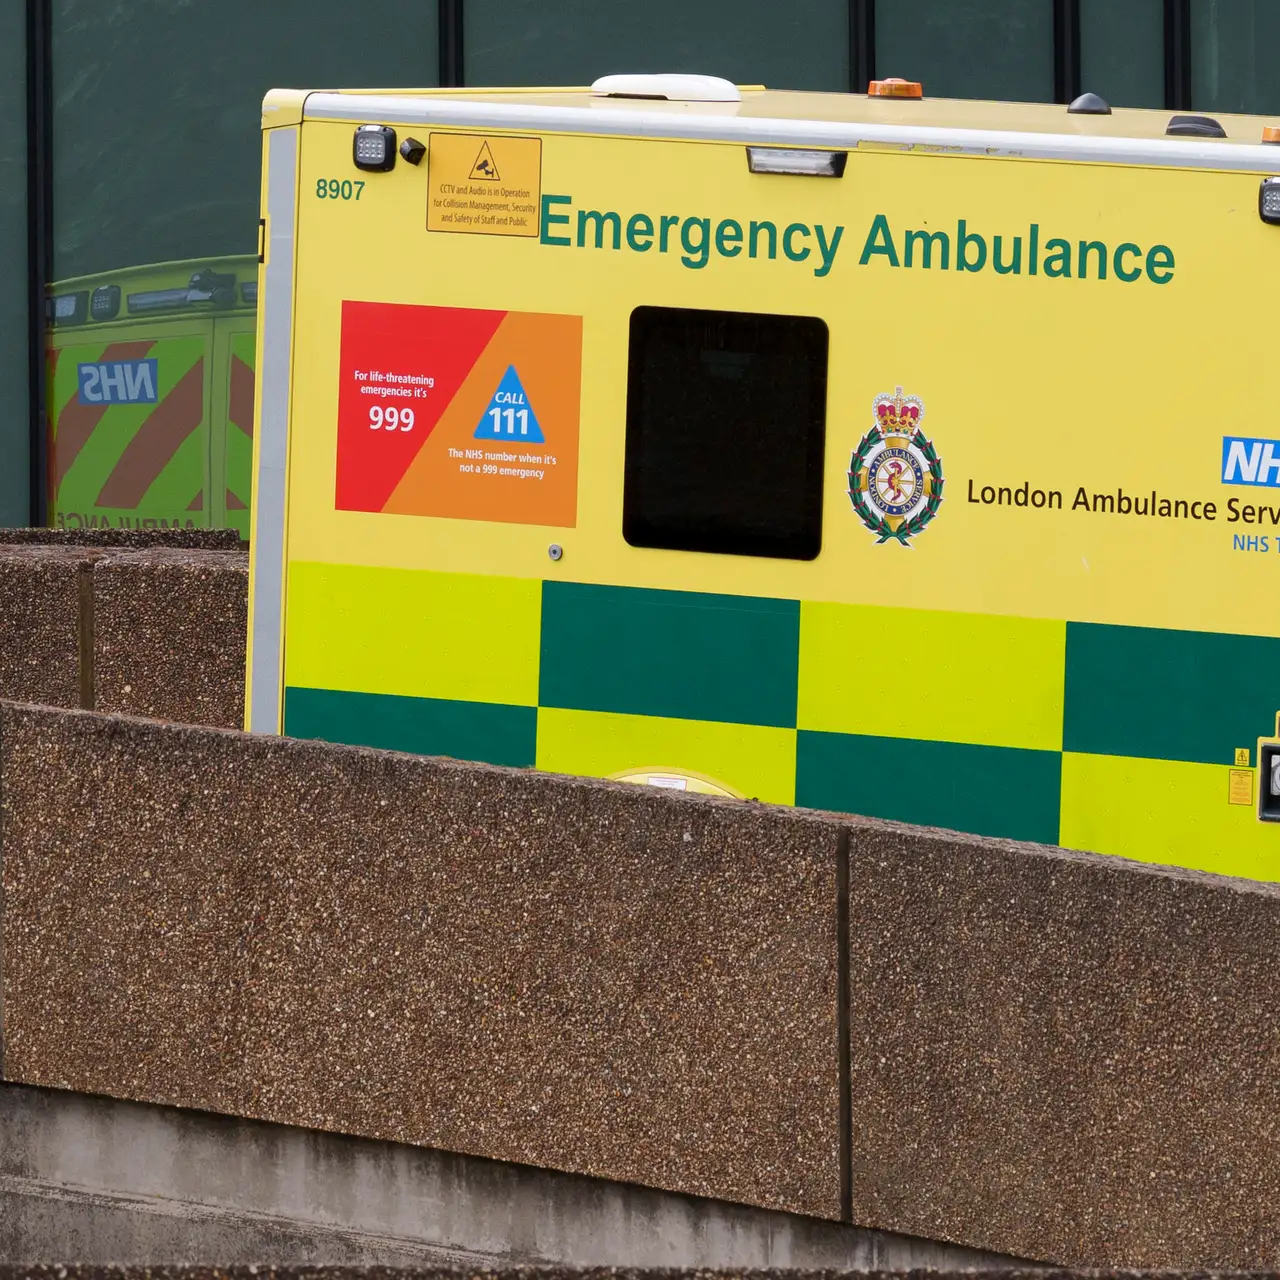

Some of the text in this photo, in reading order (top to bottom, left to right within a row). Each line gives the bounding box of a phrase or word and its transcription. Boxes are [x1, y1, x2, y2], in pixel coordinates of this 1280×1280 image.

[315, 177, 366, 202] 8907
[440, 184, 530, 198] CCTV and Audio is in Operation
[434, 198, 536, 214] for Collision Management, Security
[441, 213, 528, 226] and Safety of Staff and Public
[540, 194, 1176, 285] Emergency Ambulance
[354, 370, 434, 388] For life-threatening
[360, 384, 427, 398] emergencies it's
[495, 391, 525, 405] CALL
[369, 405, 415, 432] 999
[488, 407, 529, 435] 111
[448, 447, 557, 466] The NHS number when it's
[873, 449, 919, 471] AMBULANCE
[460, 463, 474, 473] not
[482, 464, 498, 475] 999
[499, 466, 545, 480] emergency
[967, 478, 1062, 511] London
[1071, 486, 1217, 523] Ambulance
[1232, 533, 1269, 555] NHS
